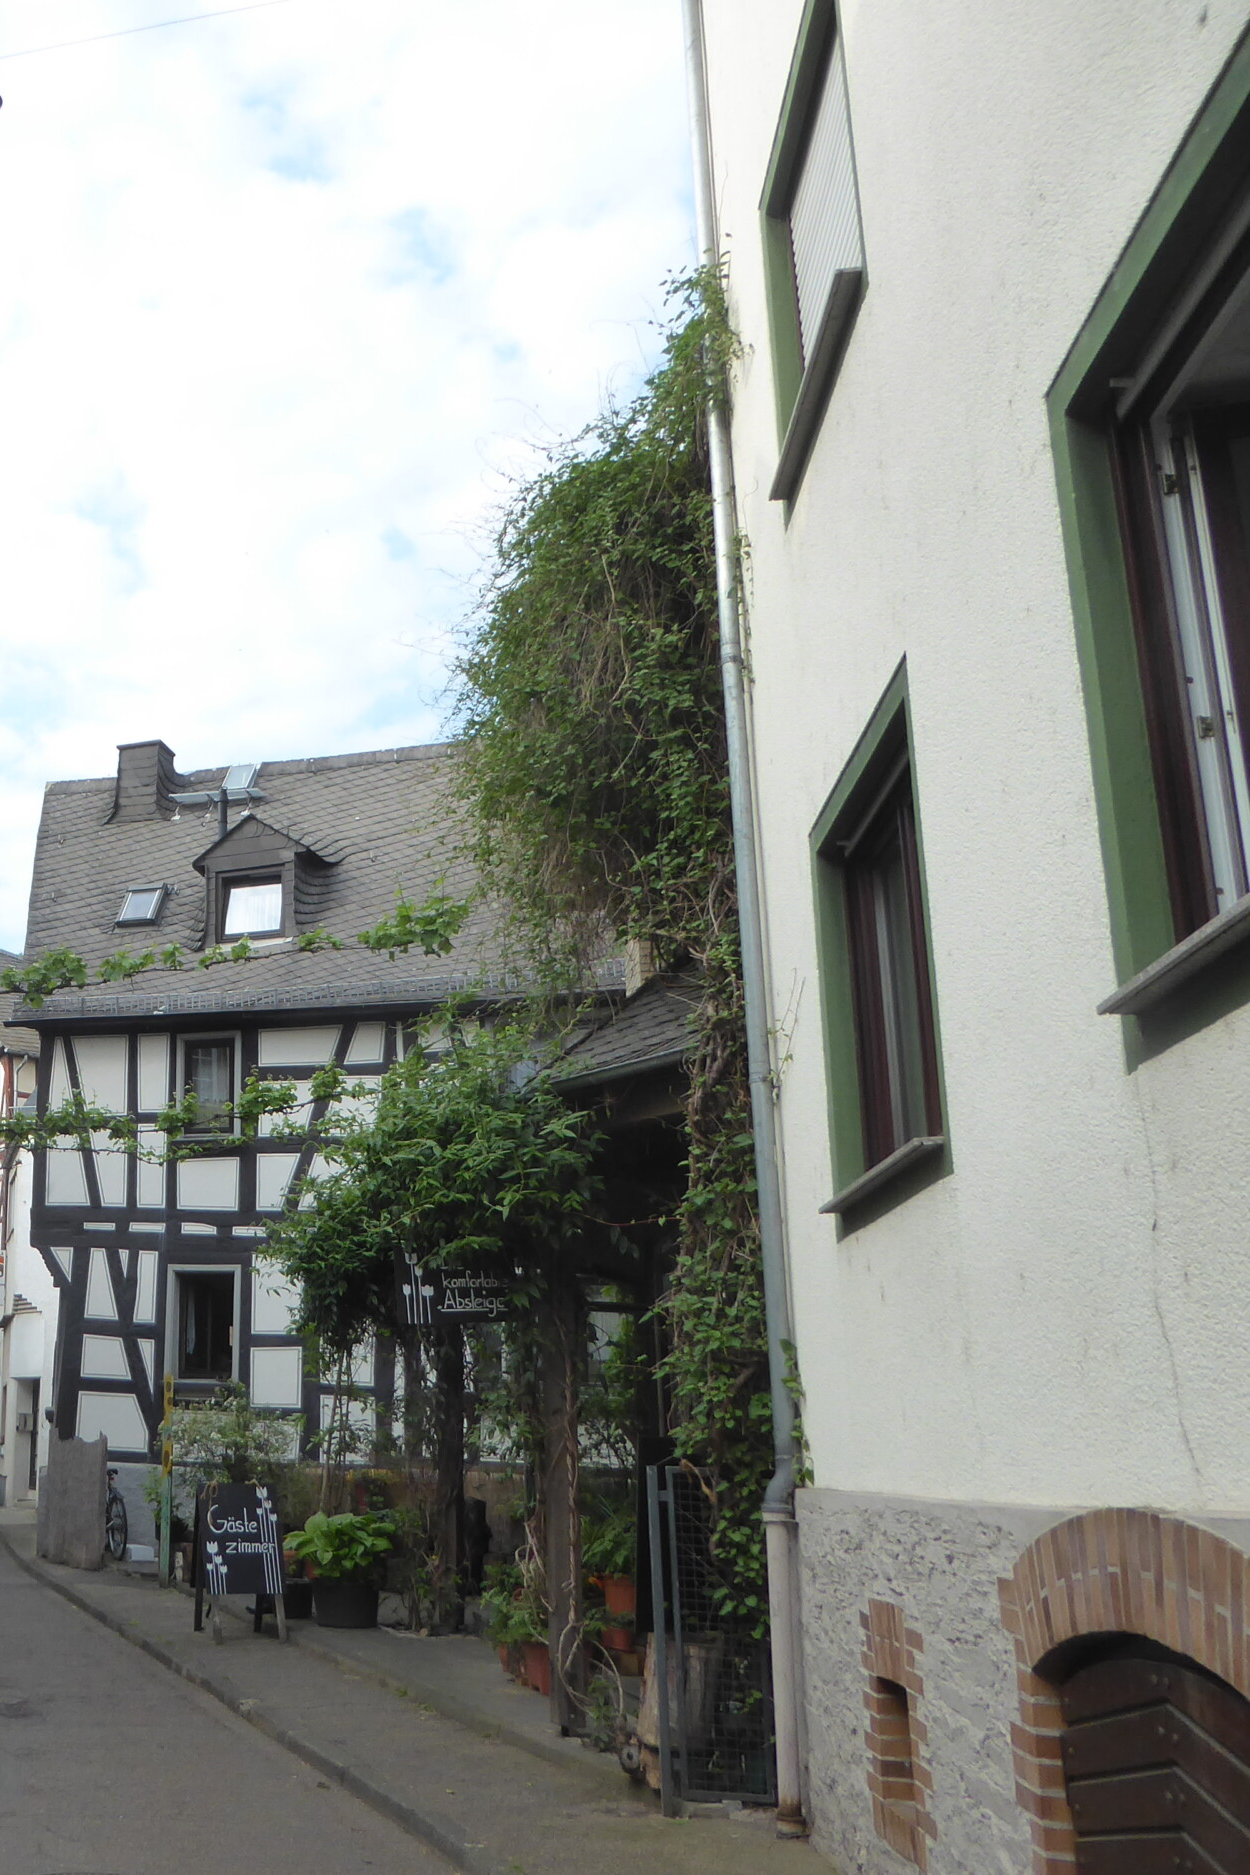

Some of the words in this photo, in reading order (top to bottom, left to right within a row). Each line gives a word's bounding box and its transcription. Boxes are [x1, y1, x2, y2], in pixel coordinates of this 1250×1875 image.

[441, 1270, 509, 1289] komfortabe
[207, 1504, 258, 1533] Gäste
[225, 1538, 276, 1554] zimmer
